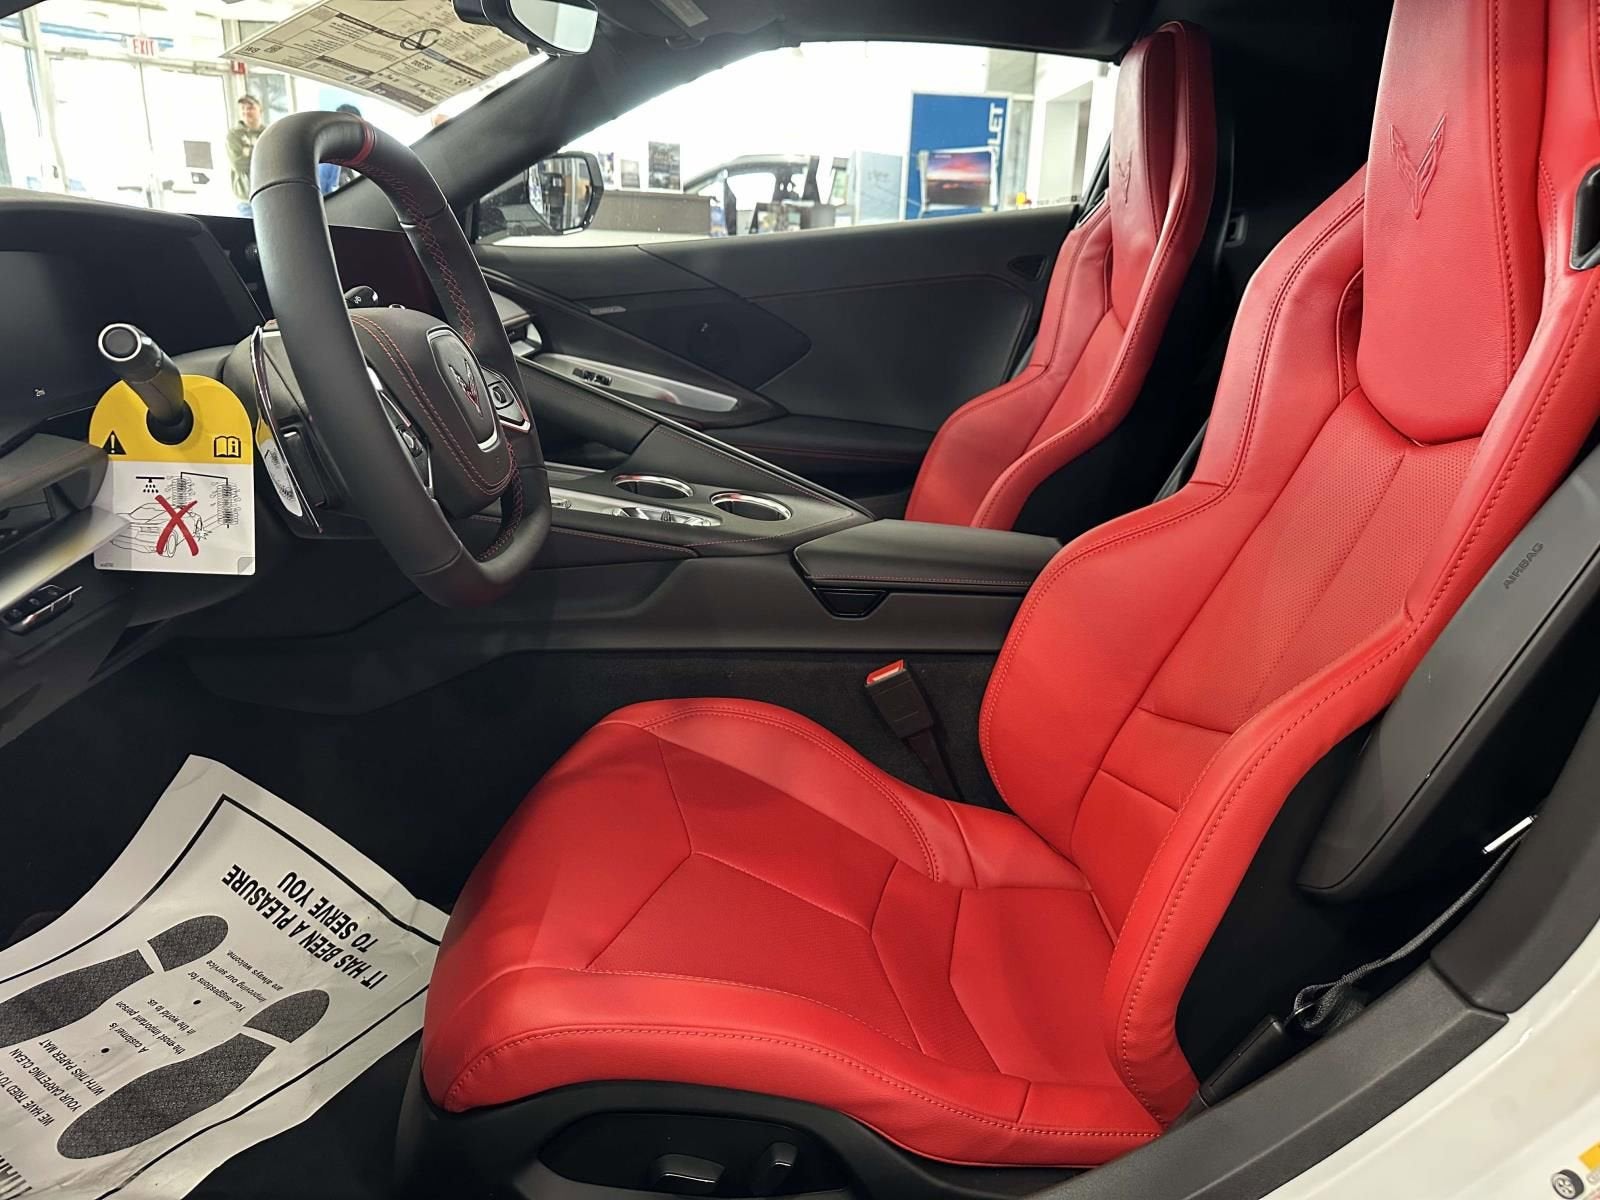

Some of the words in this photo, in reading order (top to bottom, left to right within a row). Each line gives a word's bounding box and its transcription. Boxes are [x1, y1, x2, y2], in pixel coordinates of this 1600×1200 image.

[132, 39, 155, 56] EXIT
[1503, 542, 1544, 590] AIRBAG
[221, 864, 298, 930] PLEASURE
[277, 871, 315, 908] YOU
[307, 896, 359, 940] SERVE
[288, 920, 310, 938] A
[299, 930, 344, 962] BEEN
[350, 933, 379, 953] TO
[188, 971, 199, 980] for
[206, 960, 228, 975] service
[333, 954, 372, 979] HAS
[225, 974, 239, 983] our
[251, 969, 273, 985] always
[360, 970, 388, 989] IT
[197, 977, 232, 1001] suggestions
[236, 981, 267, 1003] improving
[271, 983, 284, 991] are
[115, 1001, 140, 1016] person
[229, 1000, 246, 1012] Your
[132, 1014, 162, 1036] important
[160, 1010, 180, 1023] world
[109, 1022, 119, 1031] is
[177, 1021, 190, 1031] the
[39, 1039, 58, 1053] MAT
[114, 1028, 142, 1048] customer
[156, 1034, 176, 1047] most
[9, 1048, 34, 1069] CLEAN
[172, 1044, 186, 1055] the
[52, 1050, 77, 1070] PAPER
[0, 1077, 13, 1088] TO
[28, 1066, 65, 1096] CARPETING
[71, 1068, 90, 1081] THIS
[6, 1085, 29, 1103] TRIED
[83, 1078, 105, 1096] WITH
[22, 1100, 45, 1117] HAVE
[59, 1093, 82, 1112] YOUR
[37, 1113, 55, 1127] WE
